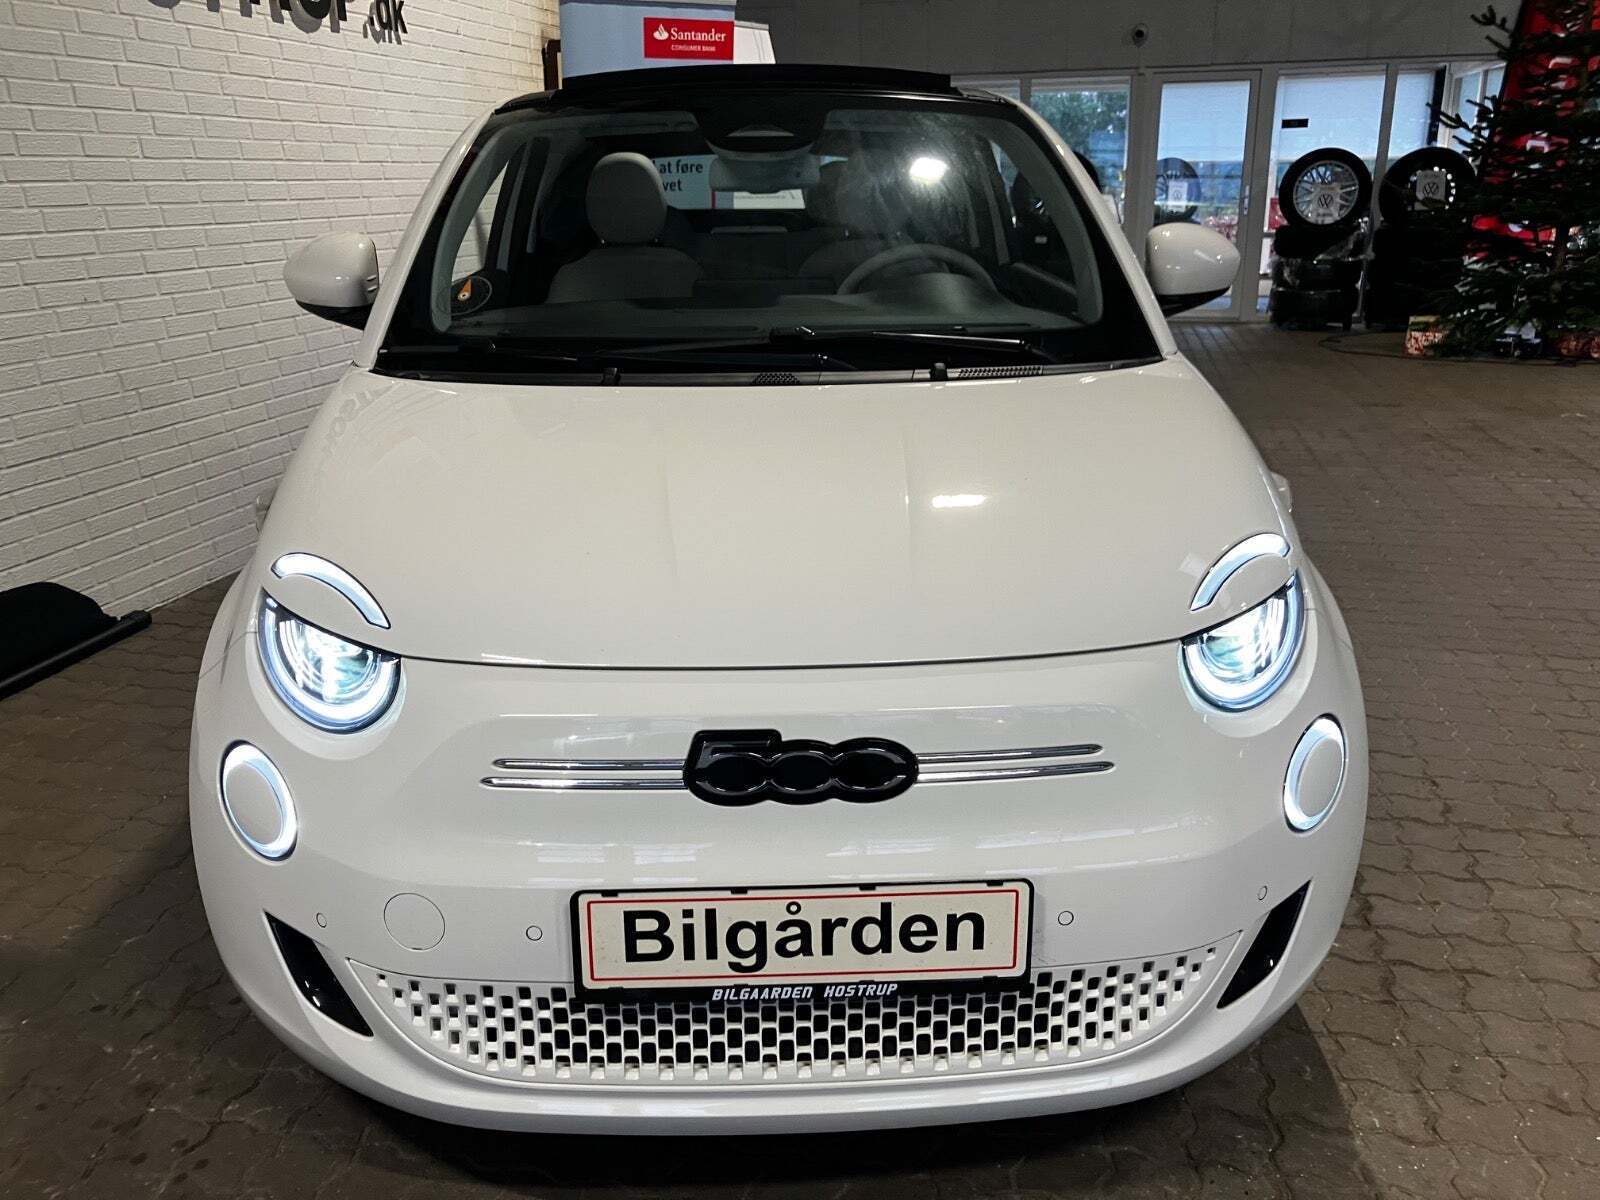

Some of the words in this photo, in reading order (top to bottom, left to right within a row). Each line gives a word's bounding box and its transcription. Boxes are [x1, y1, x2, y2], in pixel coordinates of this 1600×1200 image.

[670, 27, 726, 42] Santander
[659, 161, 672, 174] at
[676, 159, 704, 174] føre
[683, 729, 919, 807] 500
[622, 901, 985, 974] Bilgården
[712, 986, 813, 1001] BILGAARDEN
[823, 983, 898, 998] HOSTRUP
